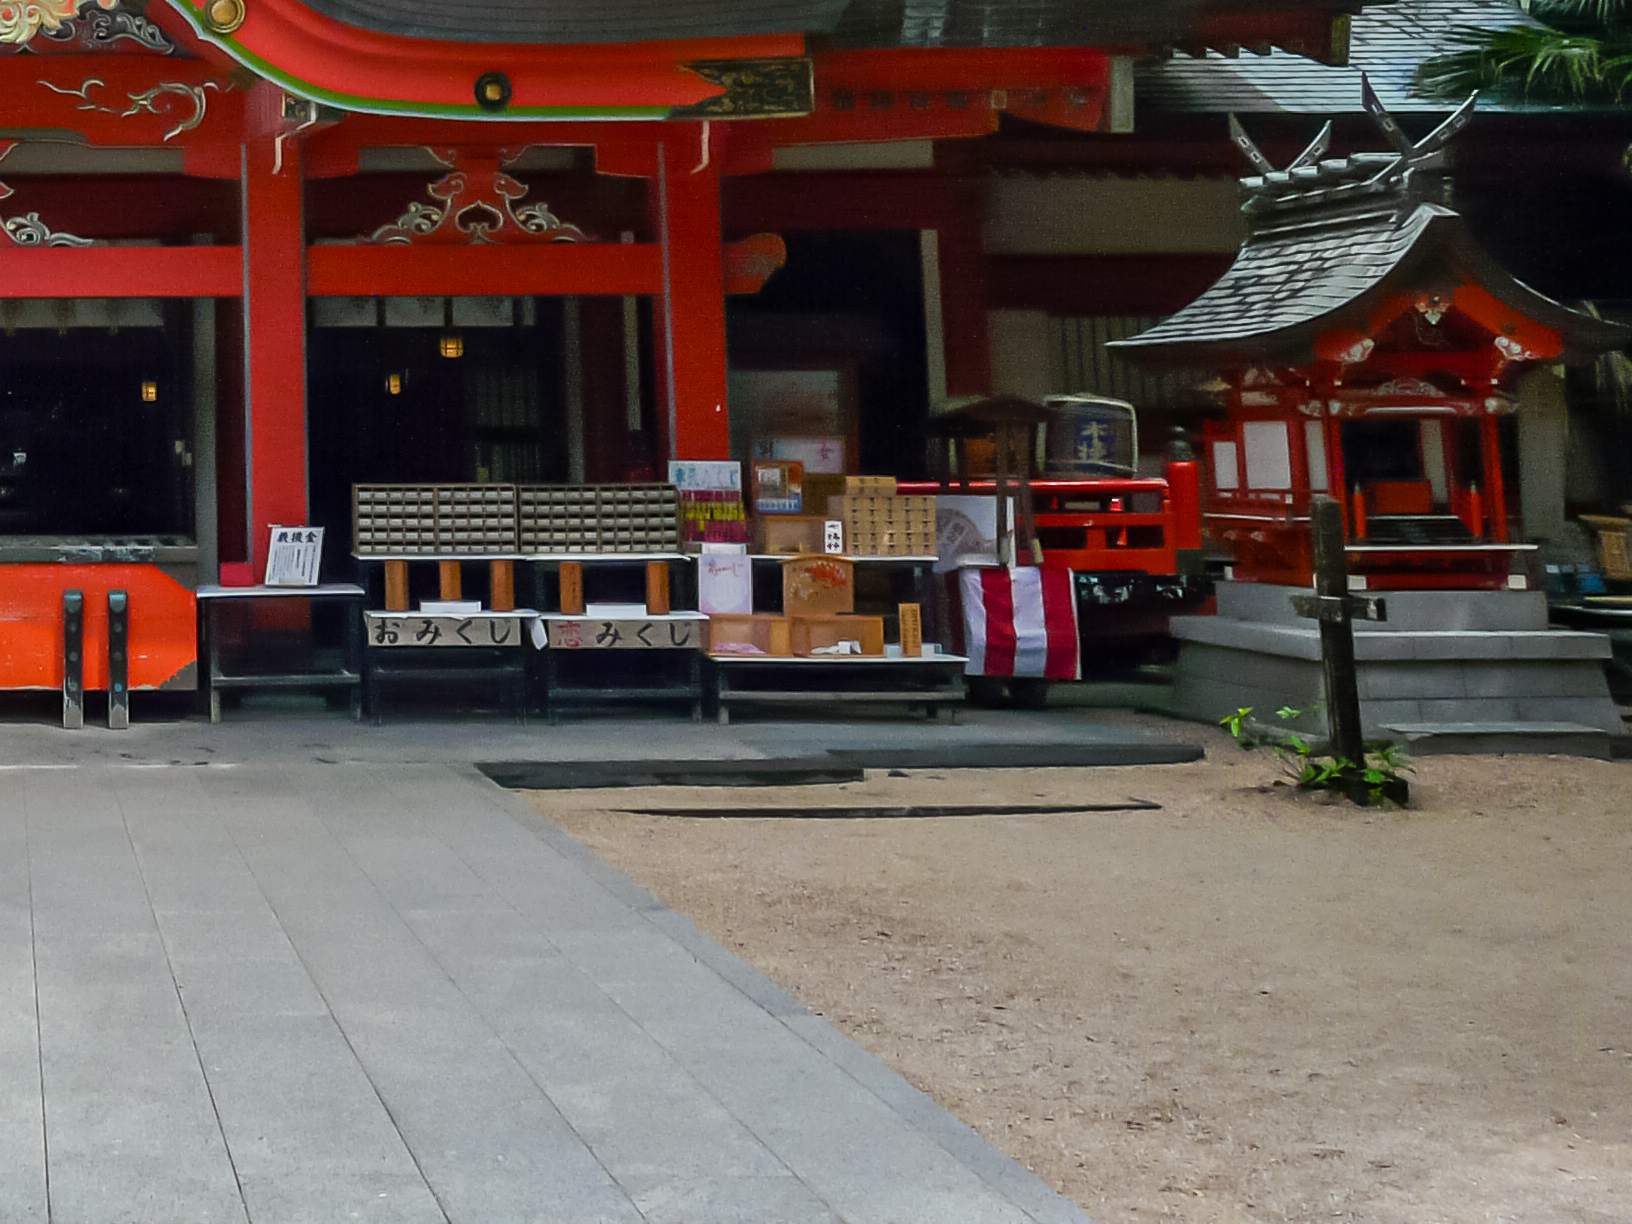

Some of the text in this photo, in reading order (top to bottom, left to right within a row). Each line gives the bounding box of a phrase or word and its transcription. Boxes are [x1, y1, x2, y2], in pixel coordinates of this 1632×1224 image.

[374, 619, 511, 645] おみくじ
[557, 622, 691, 649] 恋みくじ
